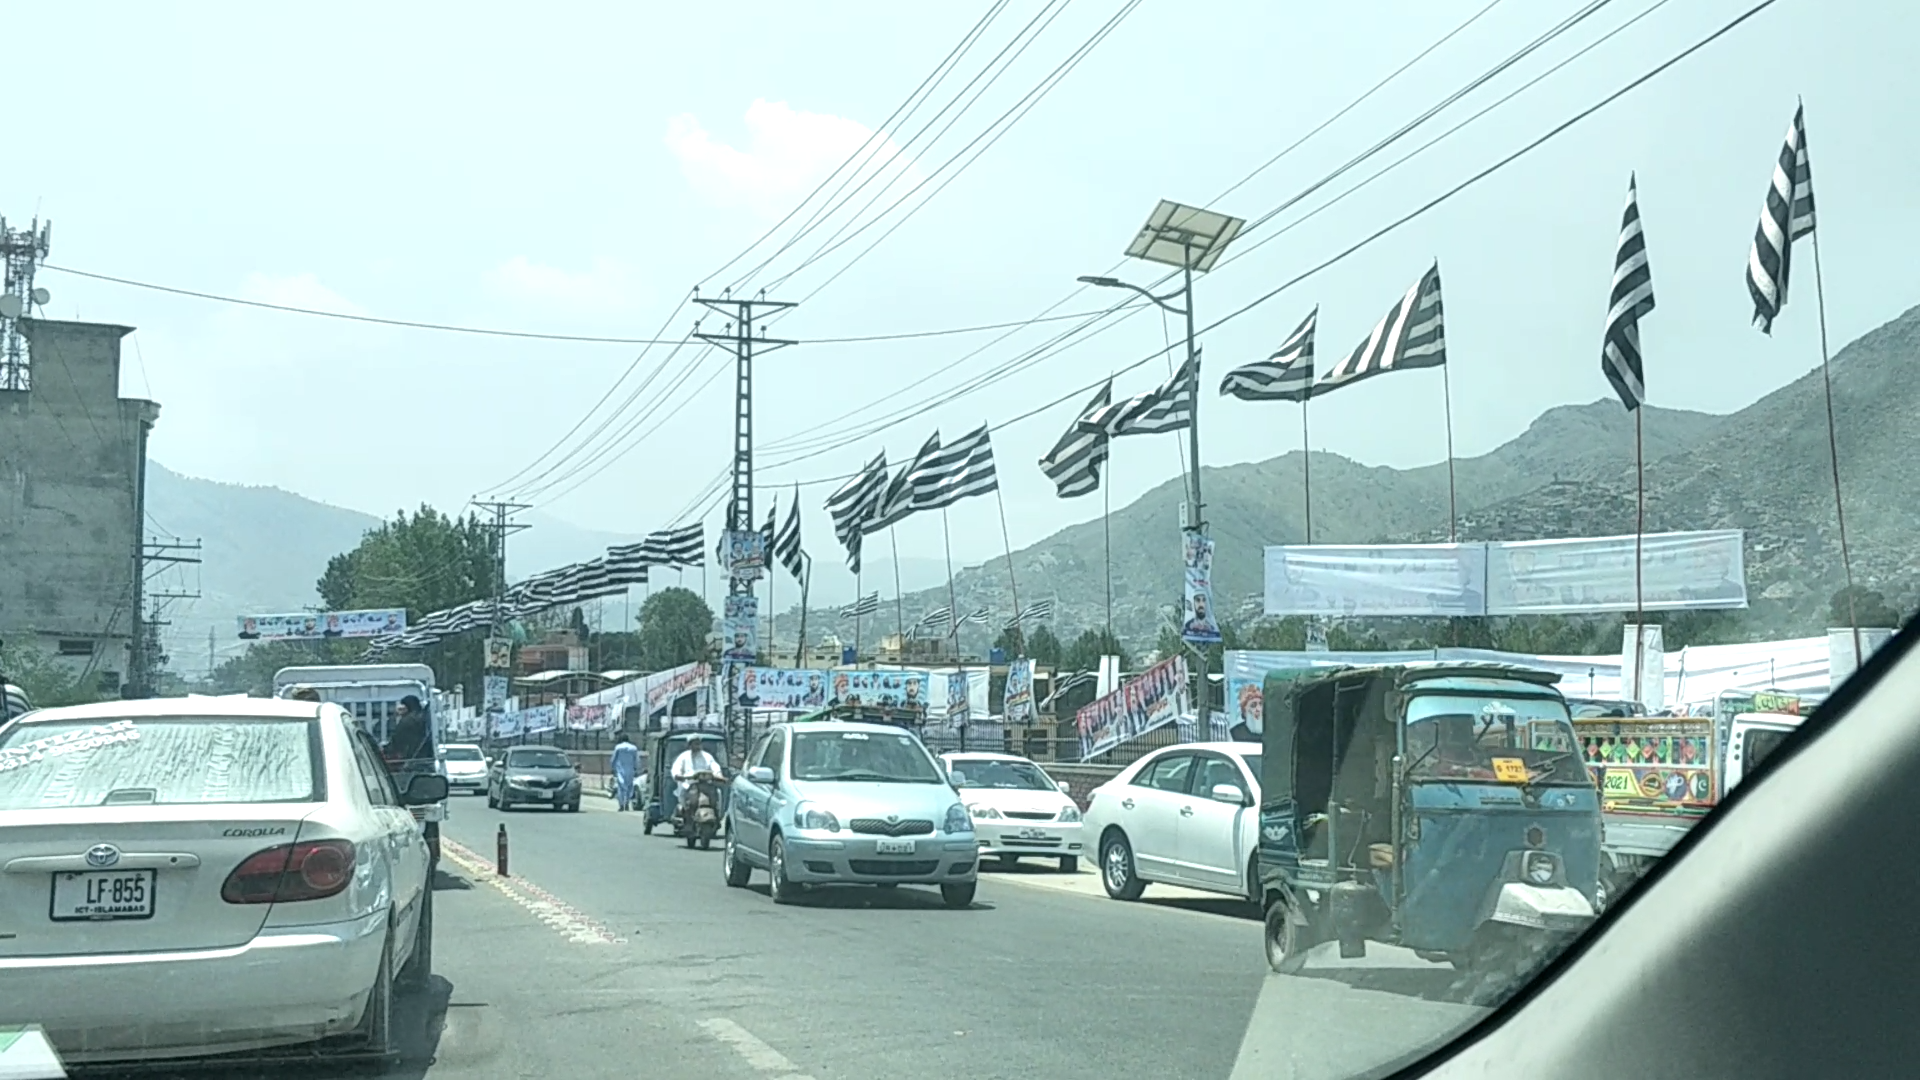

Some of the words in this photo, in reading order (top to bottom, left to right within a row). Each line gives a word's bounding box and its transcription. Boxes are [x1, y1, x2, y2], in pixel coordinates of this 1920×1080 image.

[1604, 775, 1629, 791] 2021
[222, 827, 286, 838] COROLLA
[86, 877, 146, 904] LF-855
